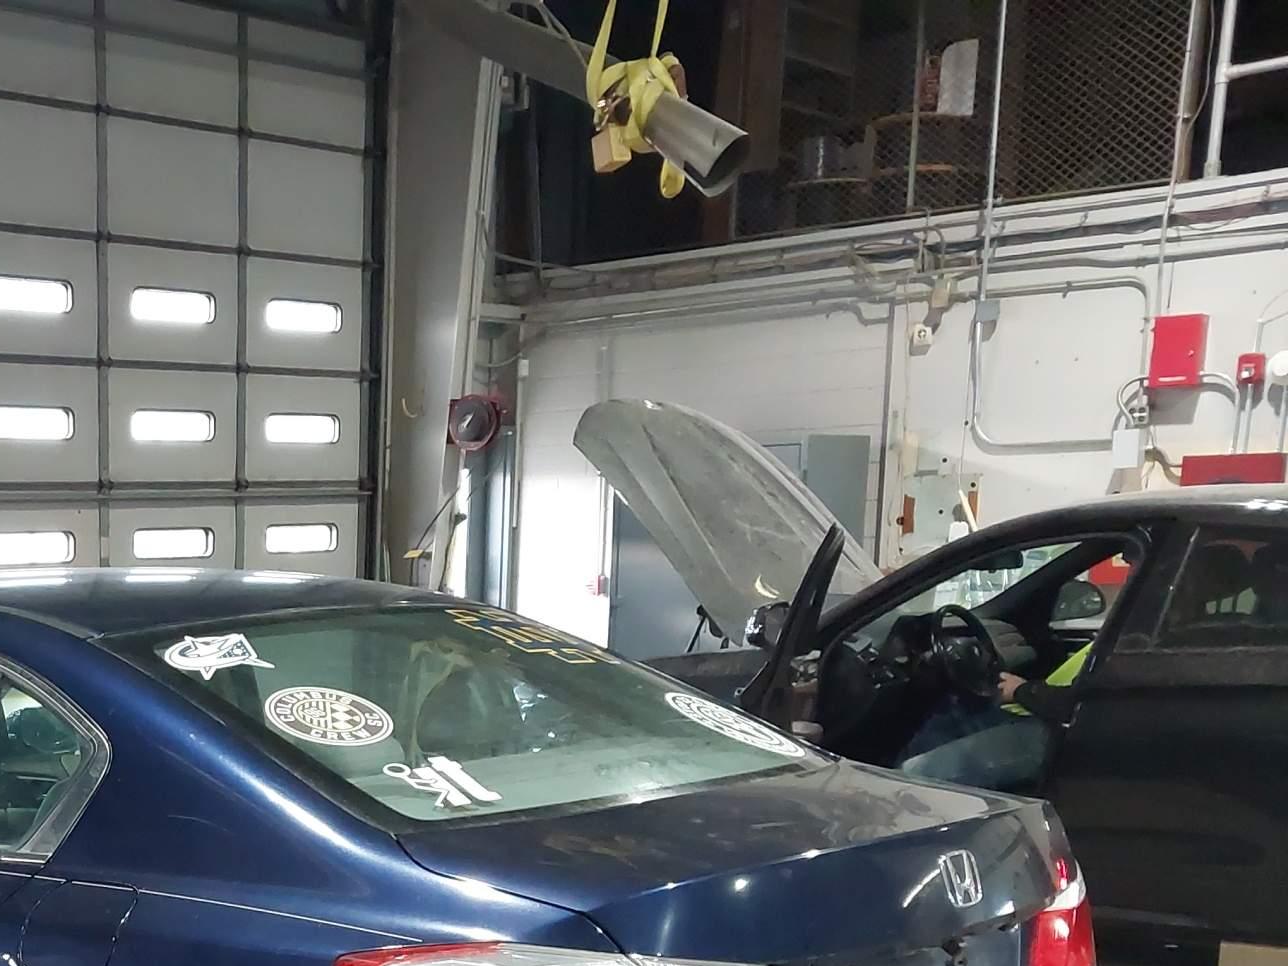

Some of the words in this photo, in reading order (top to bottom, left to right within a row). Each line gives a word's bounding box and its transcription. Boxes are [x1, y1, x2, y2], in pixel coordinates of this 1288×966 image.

[275, 690, 353, 722] COLUMBUS
[310, 728, 372, 741] CREW
[364, 712, 383, 727] SC
